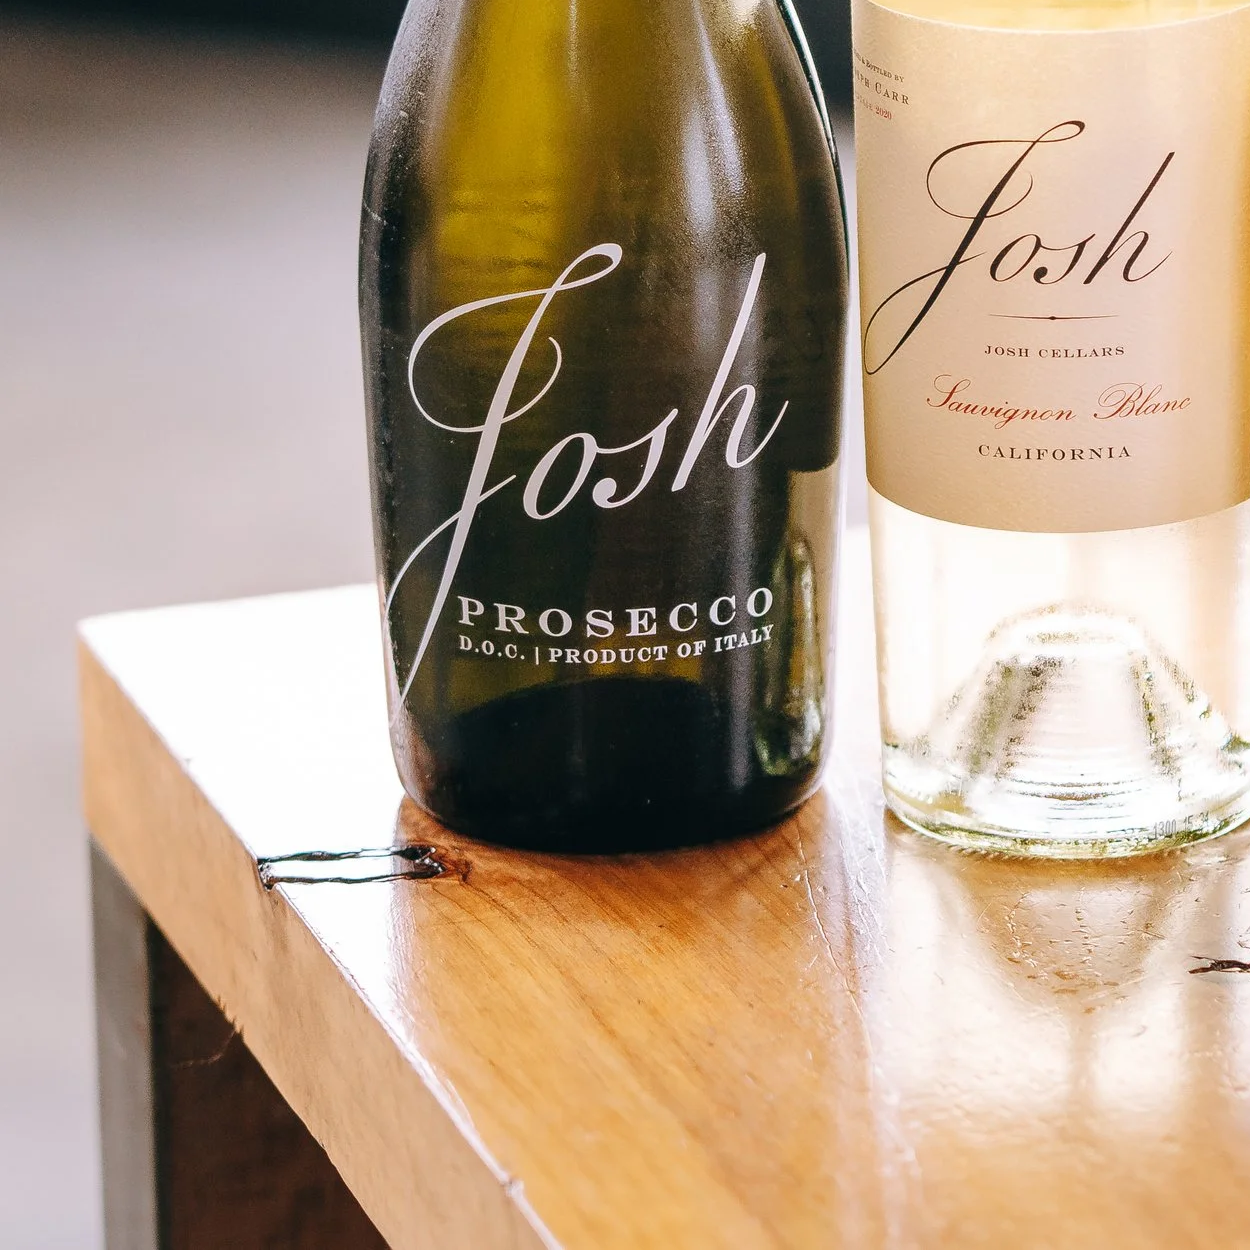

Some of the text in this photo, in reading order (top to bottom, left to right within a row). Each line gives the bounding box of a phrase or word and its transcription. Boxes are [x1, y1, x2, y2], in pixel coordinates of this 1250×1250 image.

[875, 82, 910, 105] CARR
[875, 106, 892, 120] 2020
[865, 120, 1174, 375] Josh
[984, 345, 1125, 358] JOSH CELLARS
[927, 374, 1191, 430] Sauvignon Blanc
[978, 444, 1132, 461] CALIFORNIA
[386, 242, 789, 706] Josh
[457, 587, 774, 638] PROSECCO
[459, 635, 526, 660] D.O.C.
[549, 646, 668, 664] PRODUCT
[677, 640, 706, 658] OF
[714, 624, 774, 653] ITALY
